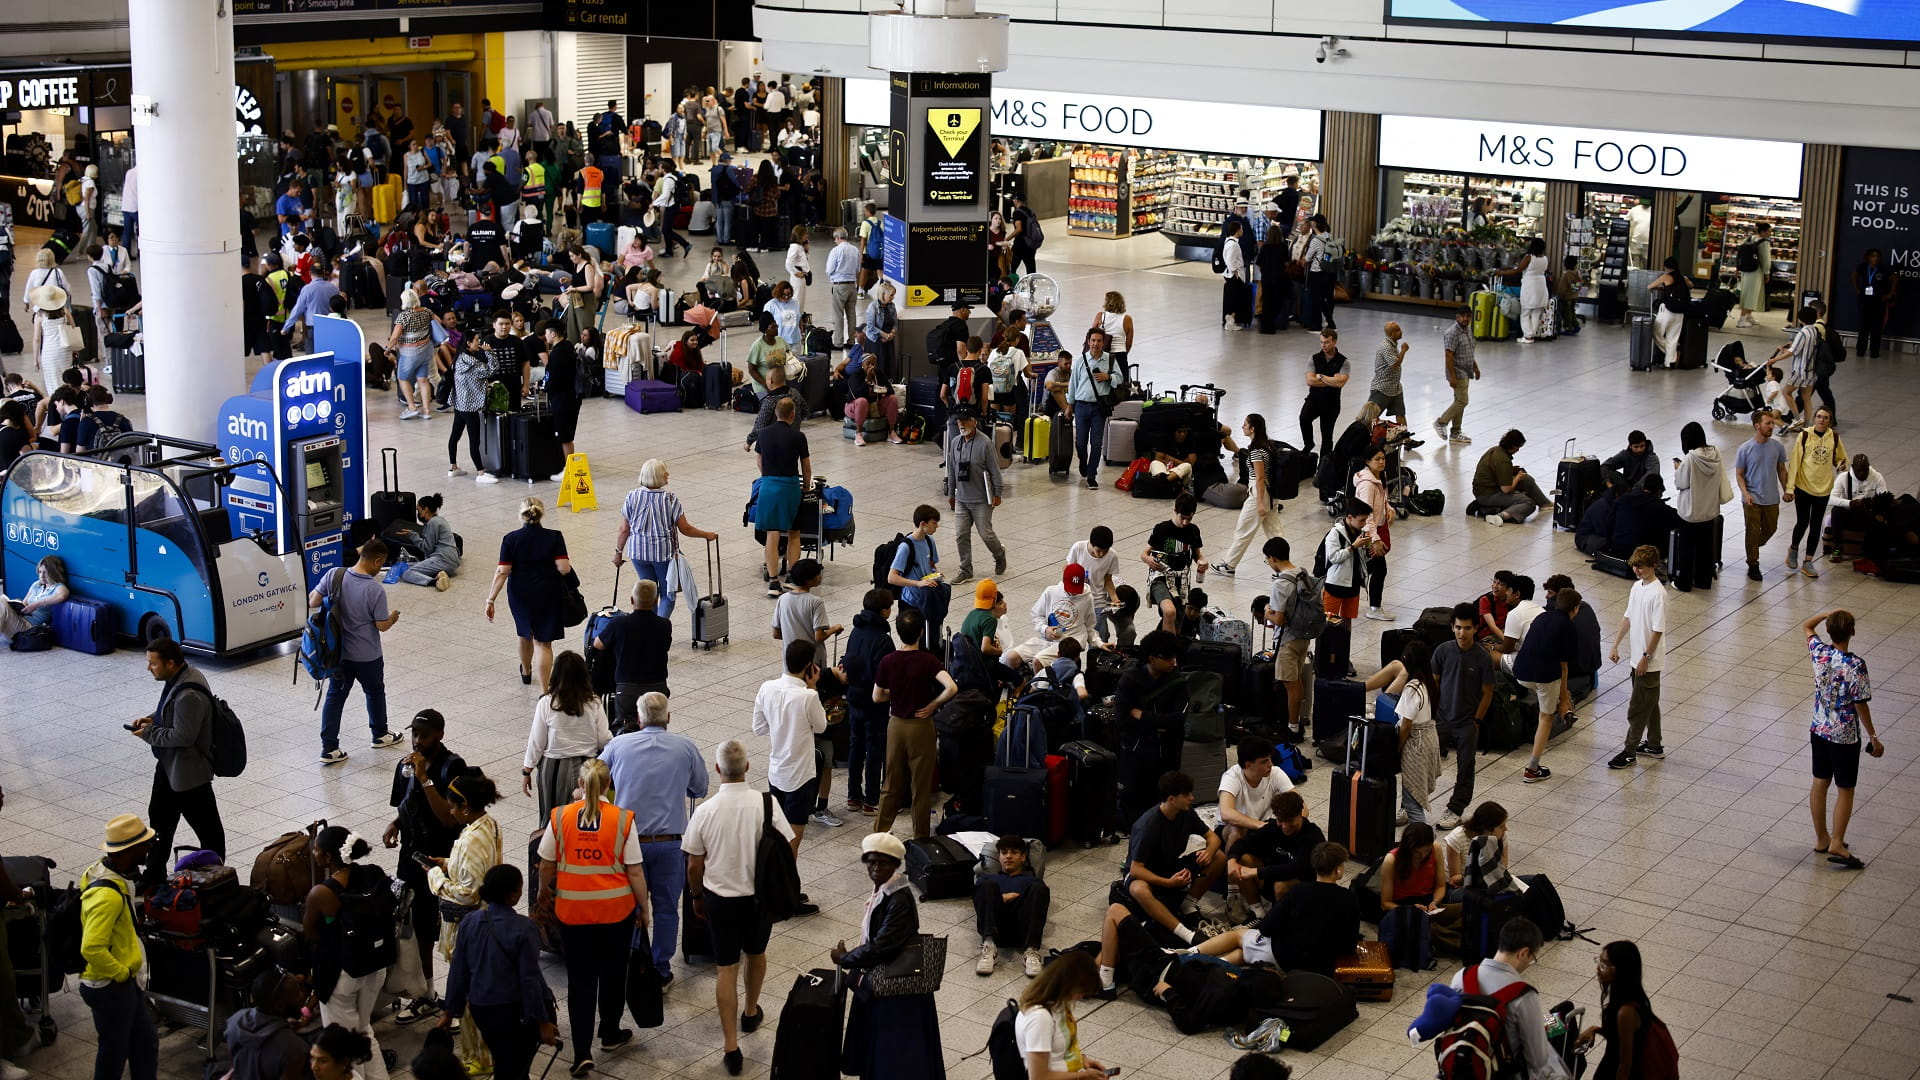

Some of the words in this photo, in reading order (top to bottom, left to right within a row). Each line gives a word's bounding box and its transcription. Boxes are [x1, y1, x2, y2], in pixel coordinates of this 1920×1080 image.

[235, 3, 254, 12] point
[307, 0, 339, 8] Smoking
[580, 10, 597, 23] Car
[599, 12, 627, 25] rental
[934, 80, 980, 89] Information
[0, 80, 13, 109] P
[18, 77, 79, 108] COFFEE
[989, 99, 1047, 128] M&S
[1063, 103, 1153, 136] FOOD
[1479, 133, 1554, 167] M&S
[1574, 140, 1687, 177] FOOD
[1854, 183, 1889, 197] THIS
[1894, 186, 1909, 198] IS
[1853, 199, 1885, 212] NOT
[1890, 203, 1920, 216] JUS
[911, 226, 933, 234] Airport
[933, 225, 968, 233] information
[1851, 216, 1909, 231] FOOD...
[1899, 270, 1920, 278] FOO
[286, 370, 332, 398] atm
[227, 412, 268, 441] atm
[232, 592, 265, 607] LONDON
[266, 584, 297, 598] GATWICK
[575, 848, 602, 860] TCO
